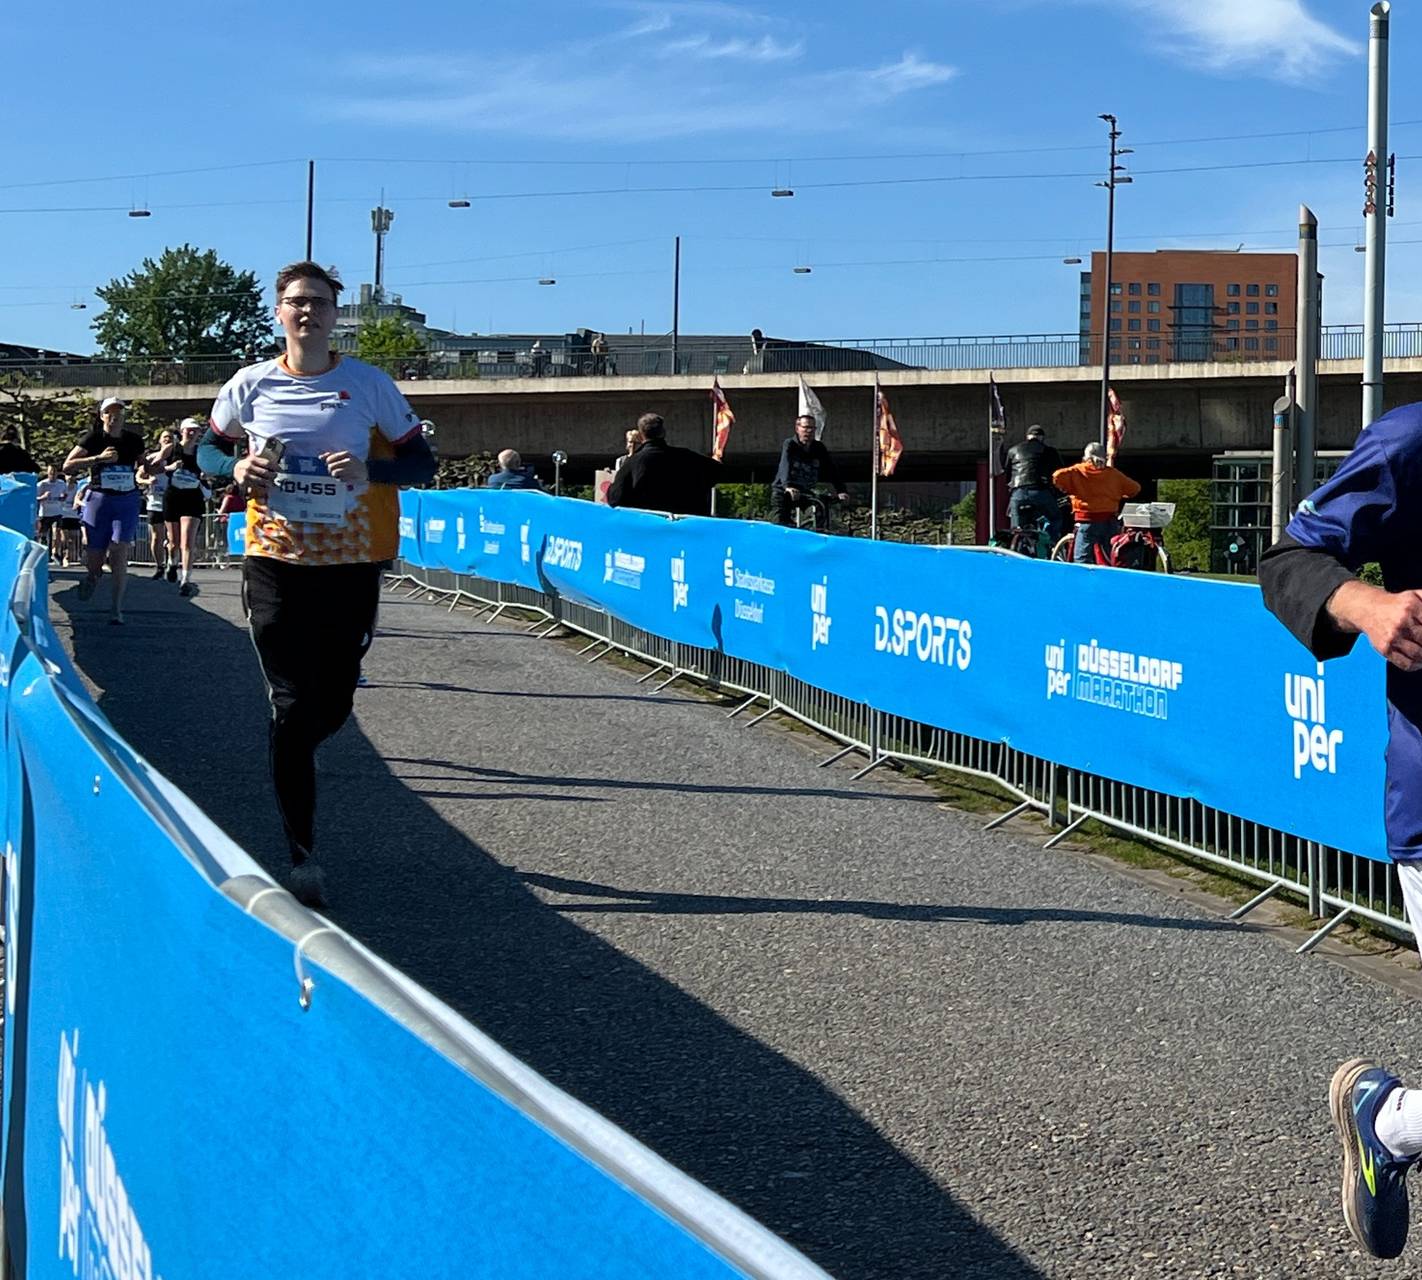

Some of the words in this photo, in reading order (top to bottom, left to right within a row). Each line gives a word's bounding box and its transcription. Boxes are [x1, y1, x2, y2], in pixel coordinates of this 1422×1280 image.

[811, 575, 827, 615] uni
[813, 613, 831, 650] per
[875, 606, 972, 670] D.SPORTS
[1045, 639, 1065, 671] uni
[1047, 670, 1071, 699] per
[1078, 639, 1182, 690] DÜSSELDORF
[1076, 672, 1168, 720] MARATHON
[1284, 661, 1325, 724] uni
[1293, 720, 1343, 779] per
